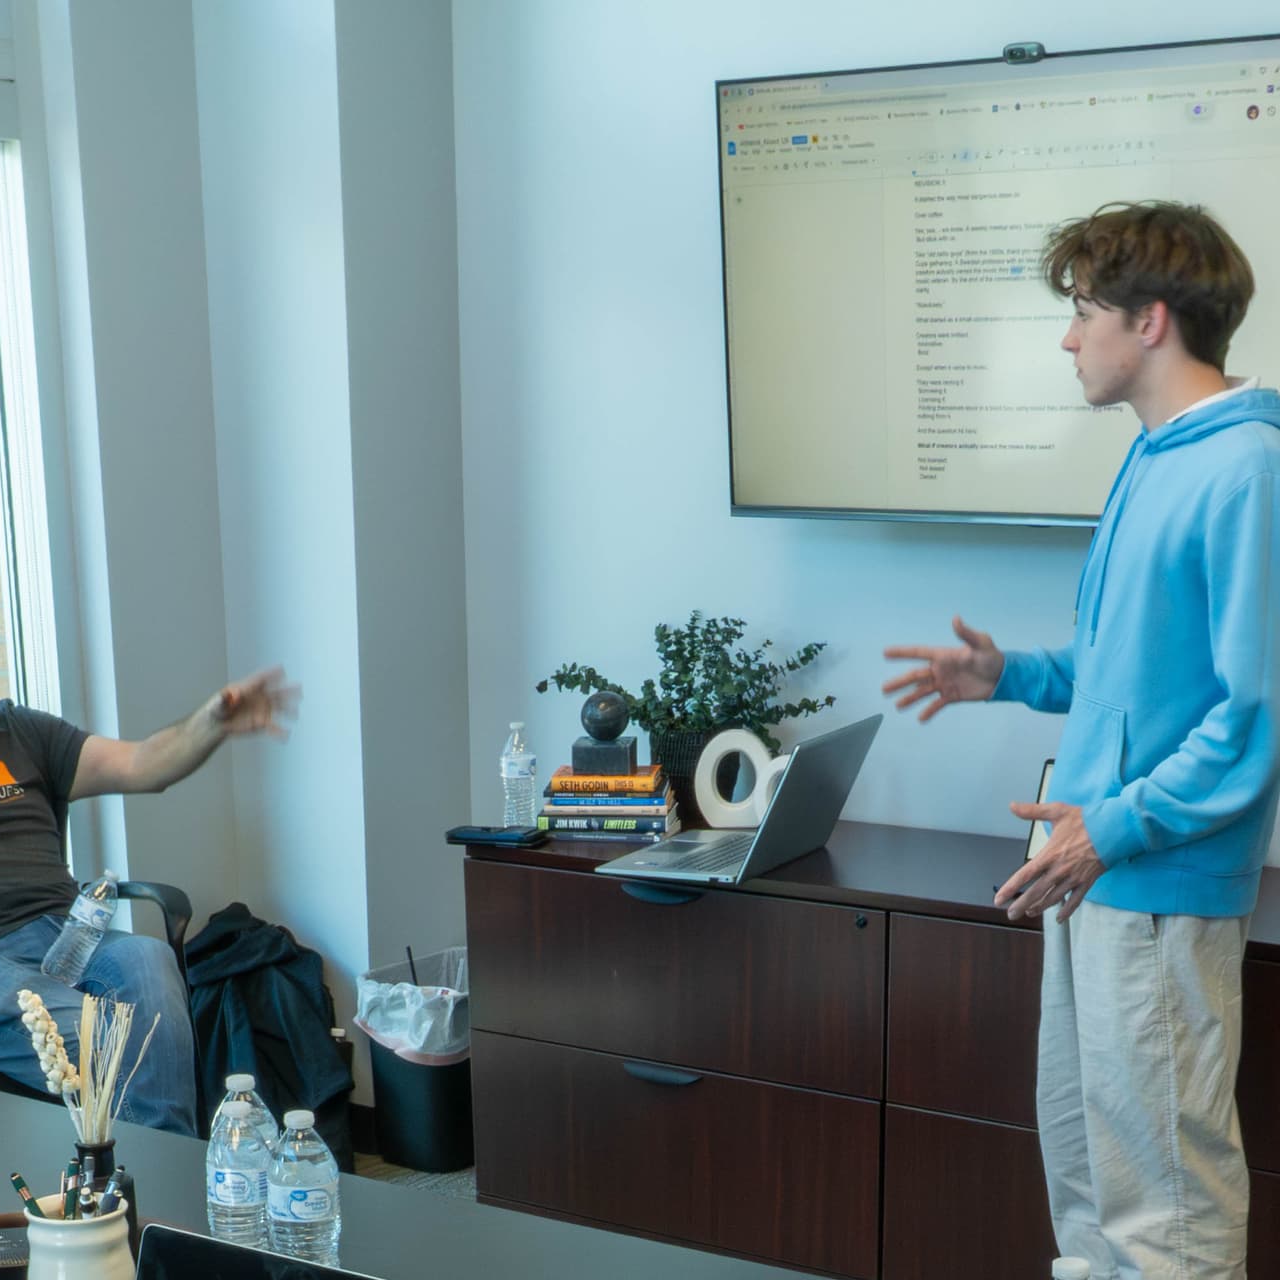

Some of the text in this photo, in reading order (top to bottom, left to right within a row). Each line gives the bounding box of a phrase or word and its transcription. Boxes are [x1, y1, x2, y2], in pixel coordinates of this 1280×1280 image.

[560, 781, 580, 792] SETH
[582, 780, 609, 792] GODIN
[555, 819, 637, 829] JIM KWIK LIMITLESS
